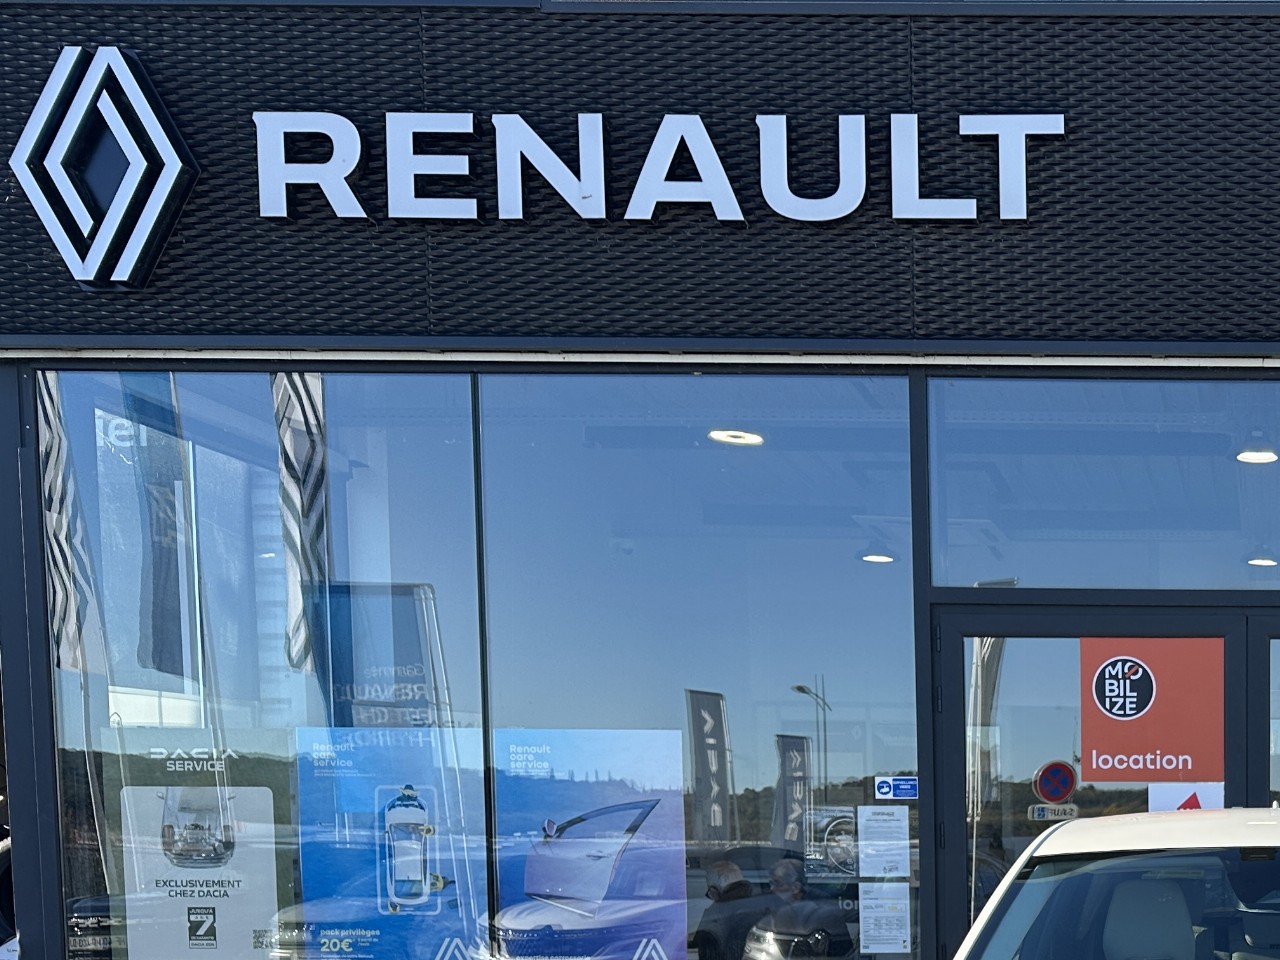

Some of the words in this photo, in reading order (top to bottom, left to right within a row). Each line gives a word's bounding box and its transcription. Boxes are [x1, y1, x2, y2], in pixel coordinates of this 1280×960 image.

[251, 110, 1066, 223] RENAULT
[312, 742, 355, 752] Renault
[509, 744, 552, 753] Renault
[150, 747, 239, 759] DACIA
[312, 751, 337, 759] care
[509, 753, 535, 761] care
[313, 758, 353, 767] service
[510, 760, 550, 768] service
[1091, 750, 1193, 770] location
[166, 760, 225, 772] SERVICE
[155, 879, 242, 888] EXCLUSIVEMENT
[168, 889, 195, 898] CHEZ
[197, 889, 229, 898] DACIA
[189, 914, 214, 936] 7
[320, 928, 340, 937] pack
[340, 928, 380, 937] privilèges
